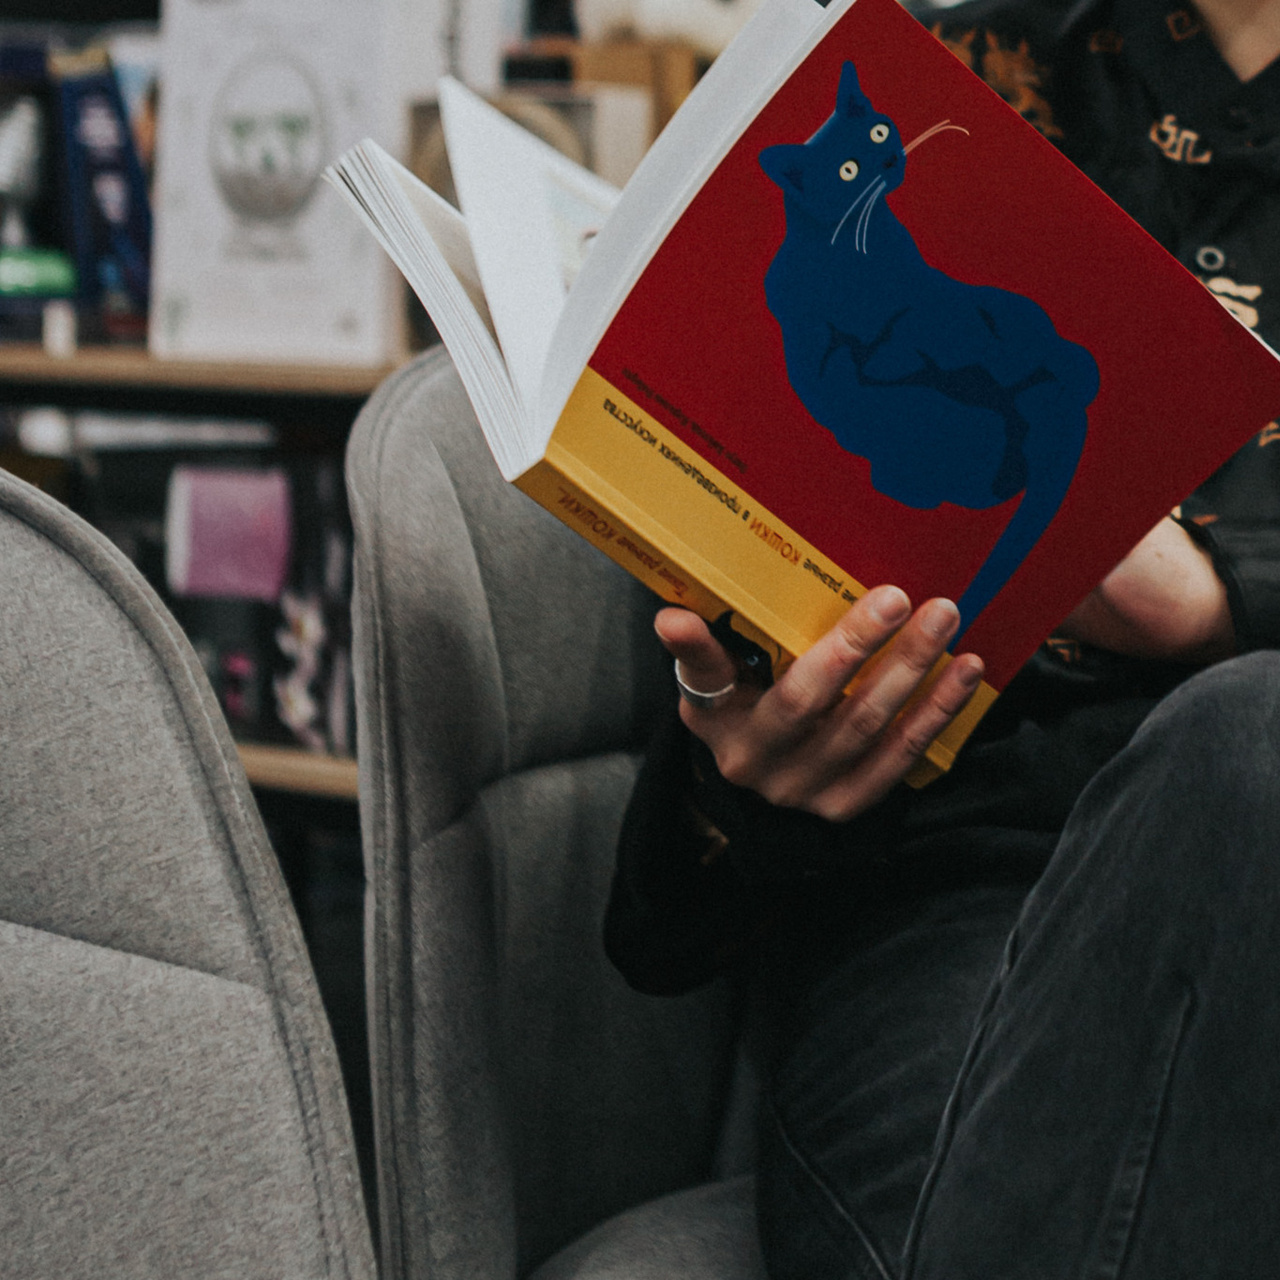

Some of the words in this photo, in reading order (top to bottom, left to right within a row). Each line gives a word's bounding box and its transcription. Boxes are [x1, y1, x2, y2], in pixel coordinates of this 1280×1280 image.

[603, 398, 658, 448] искусства
[658, 443, 742, 515] произведениях
[750, 517, 802, 566] КОШКИ
[803, 558, 844, 594] разные
